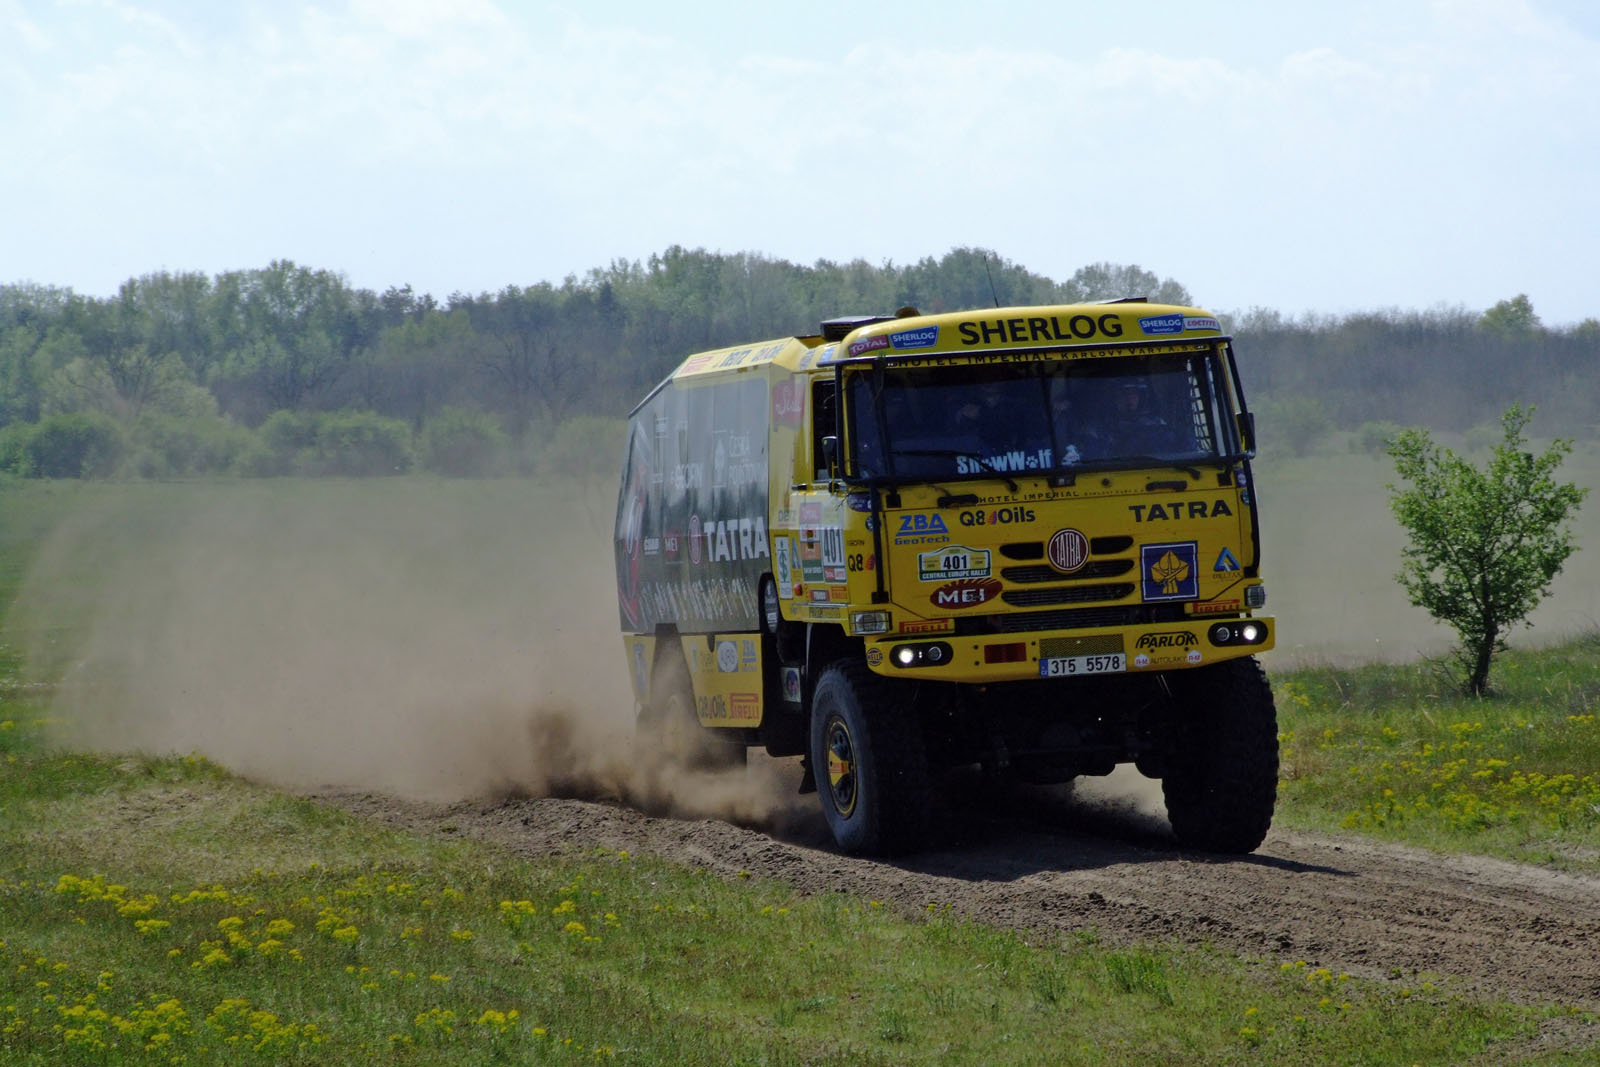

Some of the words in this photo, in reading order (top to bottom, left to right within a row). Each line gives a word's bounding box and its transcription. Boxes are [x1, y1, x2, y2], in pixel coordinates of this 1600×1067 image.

[958, 313, 1123, 345] SHERLOG
[1141, 318, 1182, 328] SHERLOG
[892, 332, 935, 342] SHERLOG
[849, 339, 888, 354] TOTAL
[967, 352, 1053, 364] IMPERIAL
[1060, 350, 1123, 360] KARLOVY
[979, 495, 1018, 503] HOTEL
[1023, 490, 1080, 500] IMPERIAL
[959, 510, 985, 527] Q8
[997, 506, 1036, 524] Oils
[1128, 500, 1233, 523] TATRA
[899, 513, 949, 532] ZBA
[703, 516, 770, 562] TATRA
[823, 528, 844, 565] 401
[894, 535, 950, 545] GeoTech
[1054, 531, 1082, 567] TATRA
[847, 553, 864, 572] Q8
[943, 554, 967, 570] 401
[922, 572, 947, 580] CENTRAL
[948, 570, 969, 578] EUROPE
[1192, 599, 1241, 613] PIRELLI
[898, 618, 949, 633] PIRELLI
[1138, 633, 1197, 649] PARLOK
[1051, 659, 1076, 675] 3T5
[1086, 655, 1120, 672] 5578
[729, 692, 760, 720] PIRELLI
